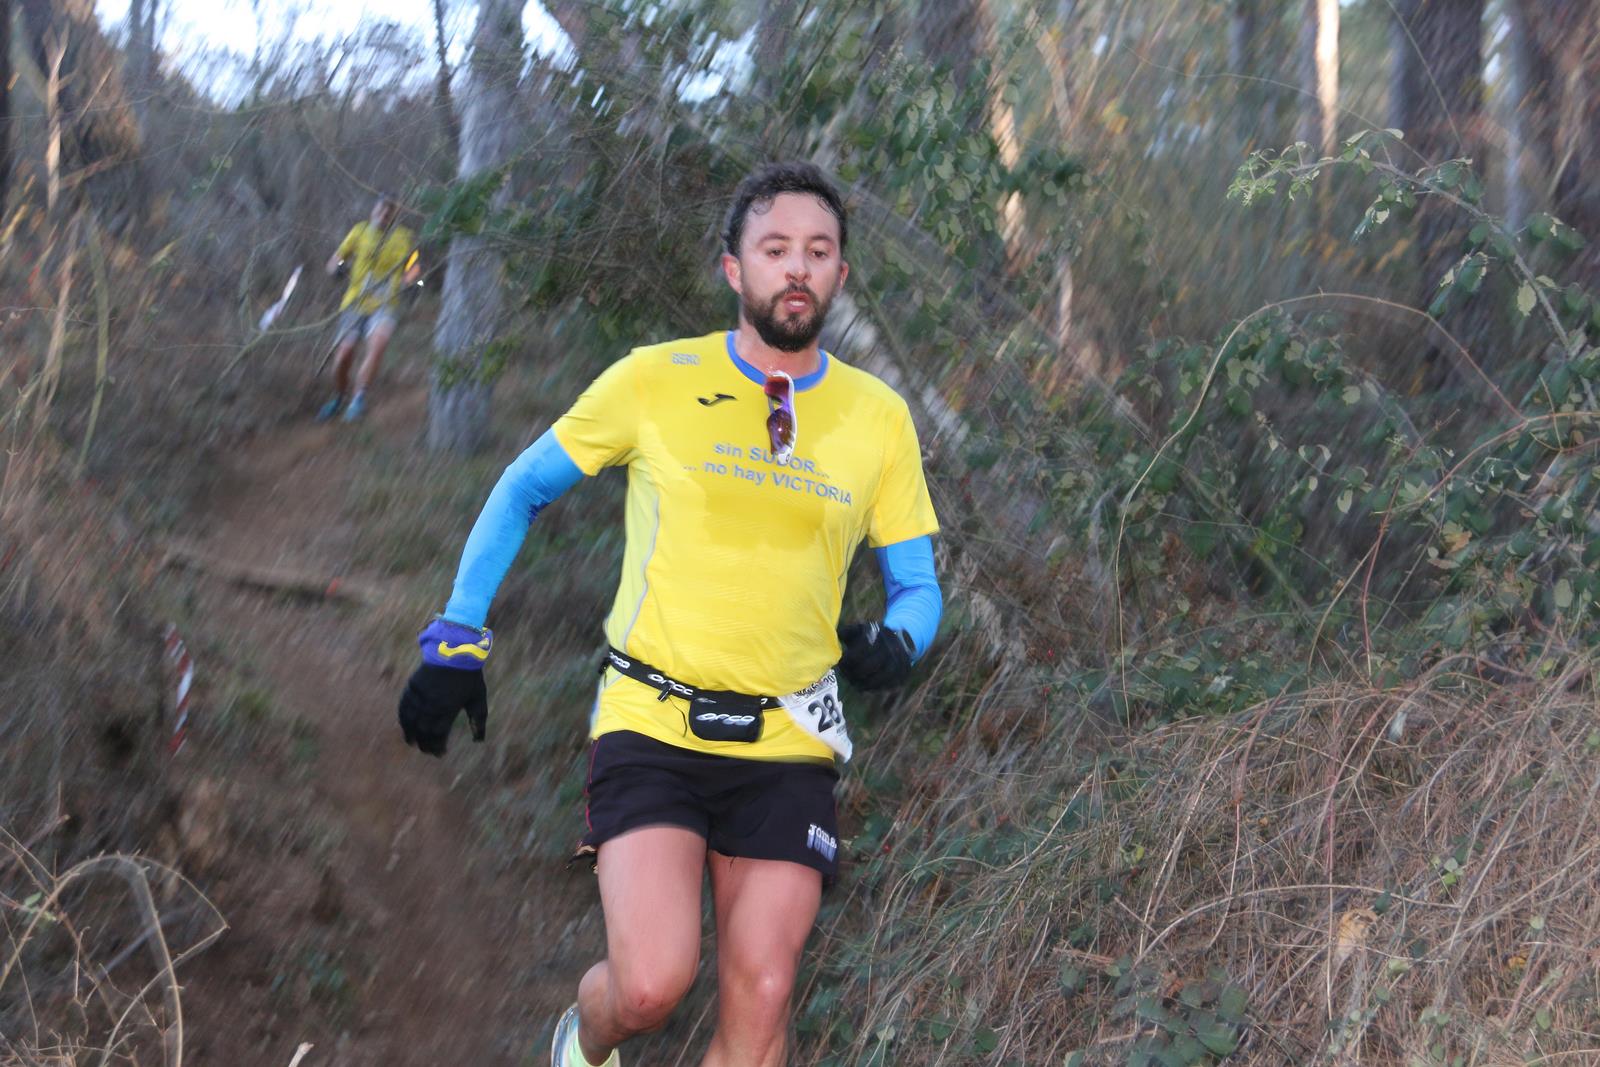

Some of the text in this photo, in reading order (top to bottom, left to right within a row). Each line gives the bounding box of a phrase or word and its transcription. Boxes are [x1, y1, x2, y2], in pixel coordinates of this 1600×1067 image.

[714, 442, 744, 458] sin
[704, 461, 727, 475] no
[733, 465, 765, 486] hay
[772, 472, 852, 507] VICTORIA
[696, 712, 756, 726] orca
[807, 692, 842, 733] 28
